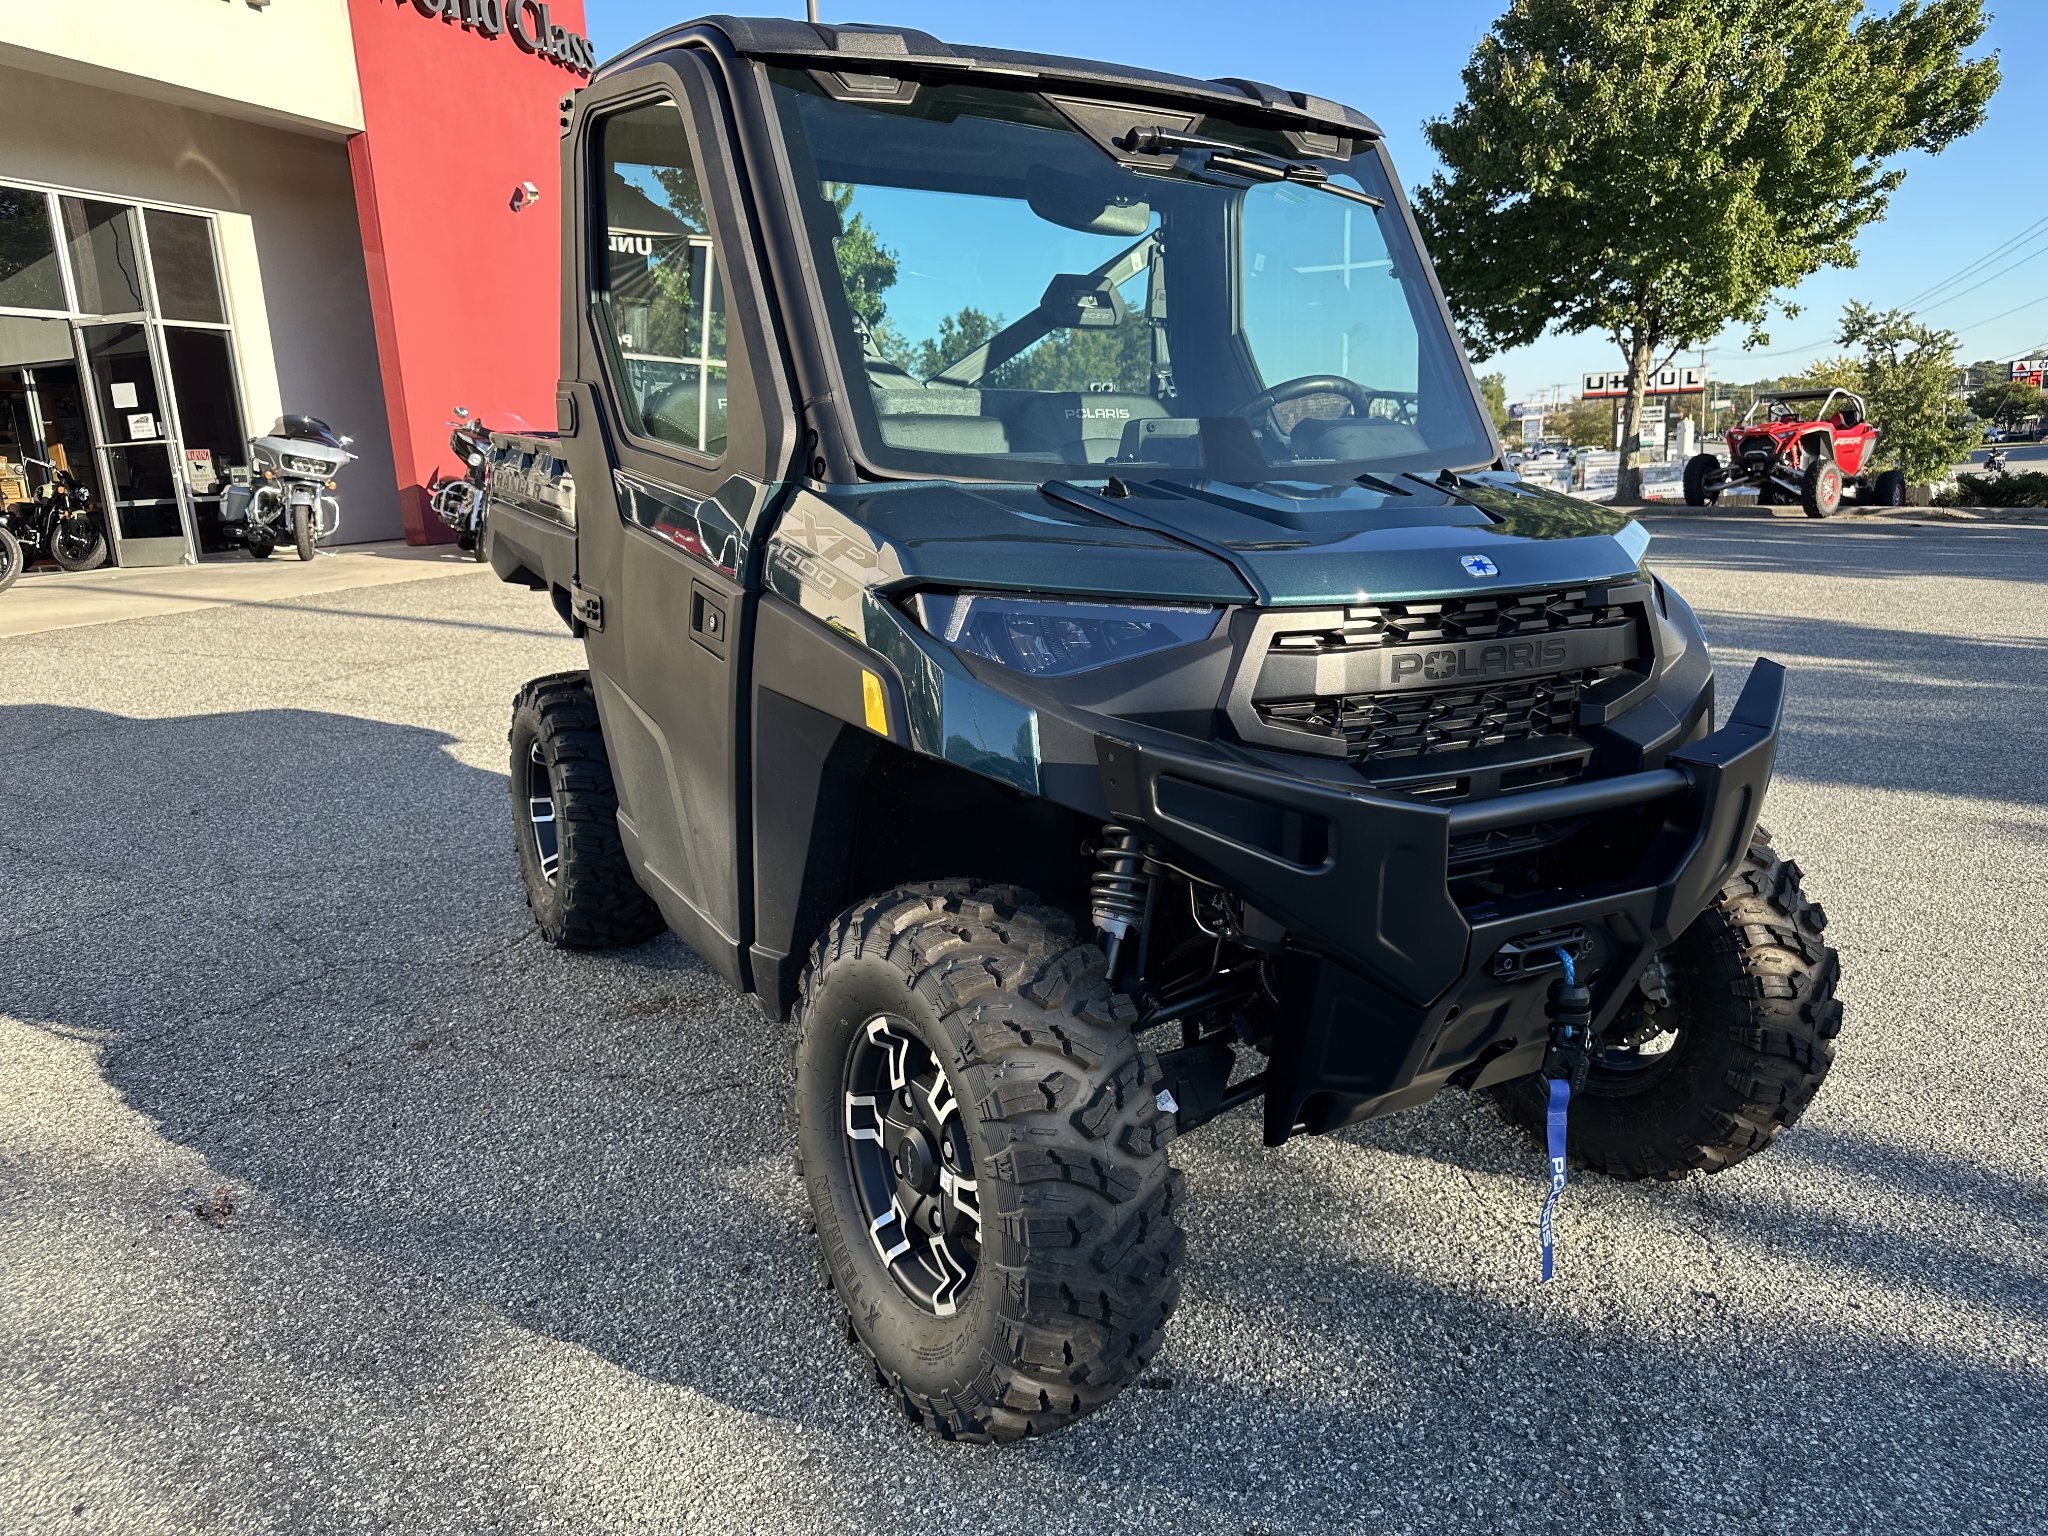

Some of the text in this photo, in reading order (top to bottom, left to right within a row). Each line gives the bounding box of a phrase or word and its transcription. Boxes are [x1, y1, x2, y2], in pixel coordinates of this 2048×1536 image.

[507, 0, 598, 75] Class
[1586, 371, 1699, 390] U-HUL
[1065, 407, 1130, 419] POLARIS
[496, 470, 542, 501] RANGER
[780, 508, 879, 569] XP
[775, 542, 838, 590] 1000
[1390, 637, 1566, 684] POLARIS
[1540, 1156, 1565, 1248] POLARIS
[813, 1174, 882, 1333] X-TERRAIN
